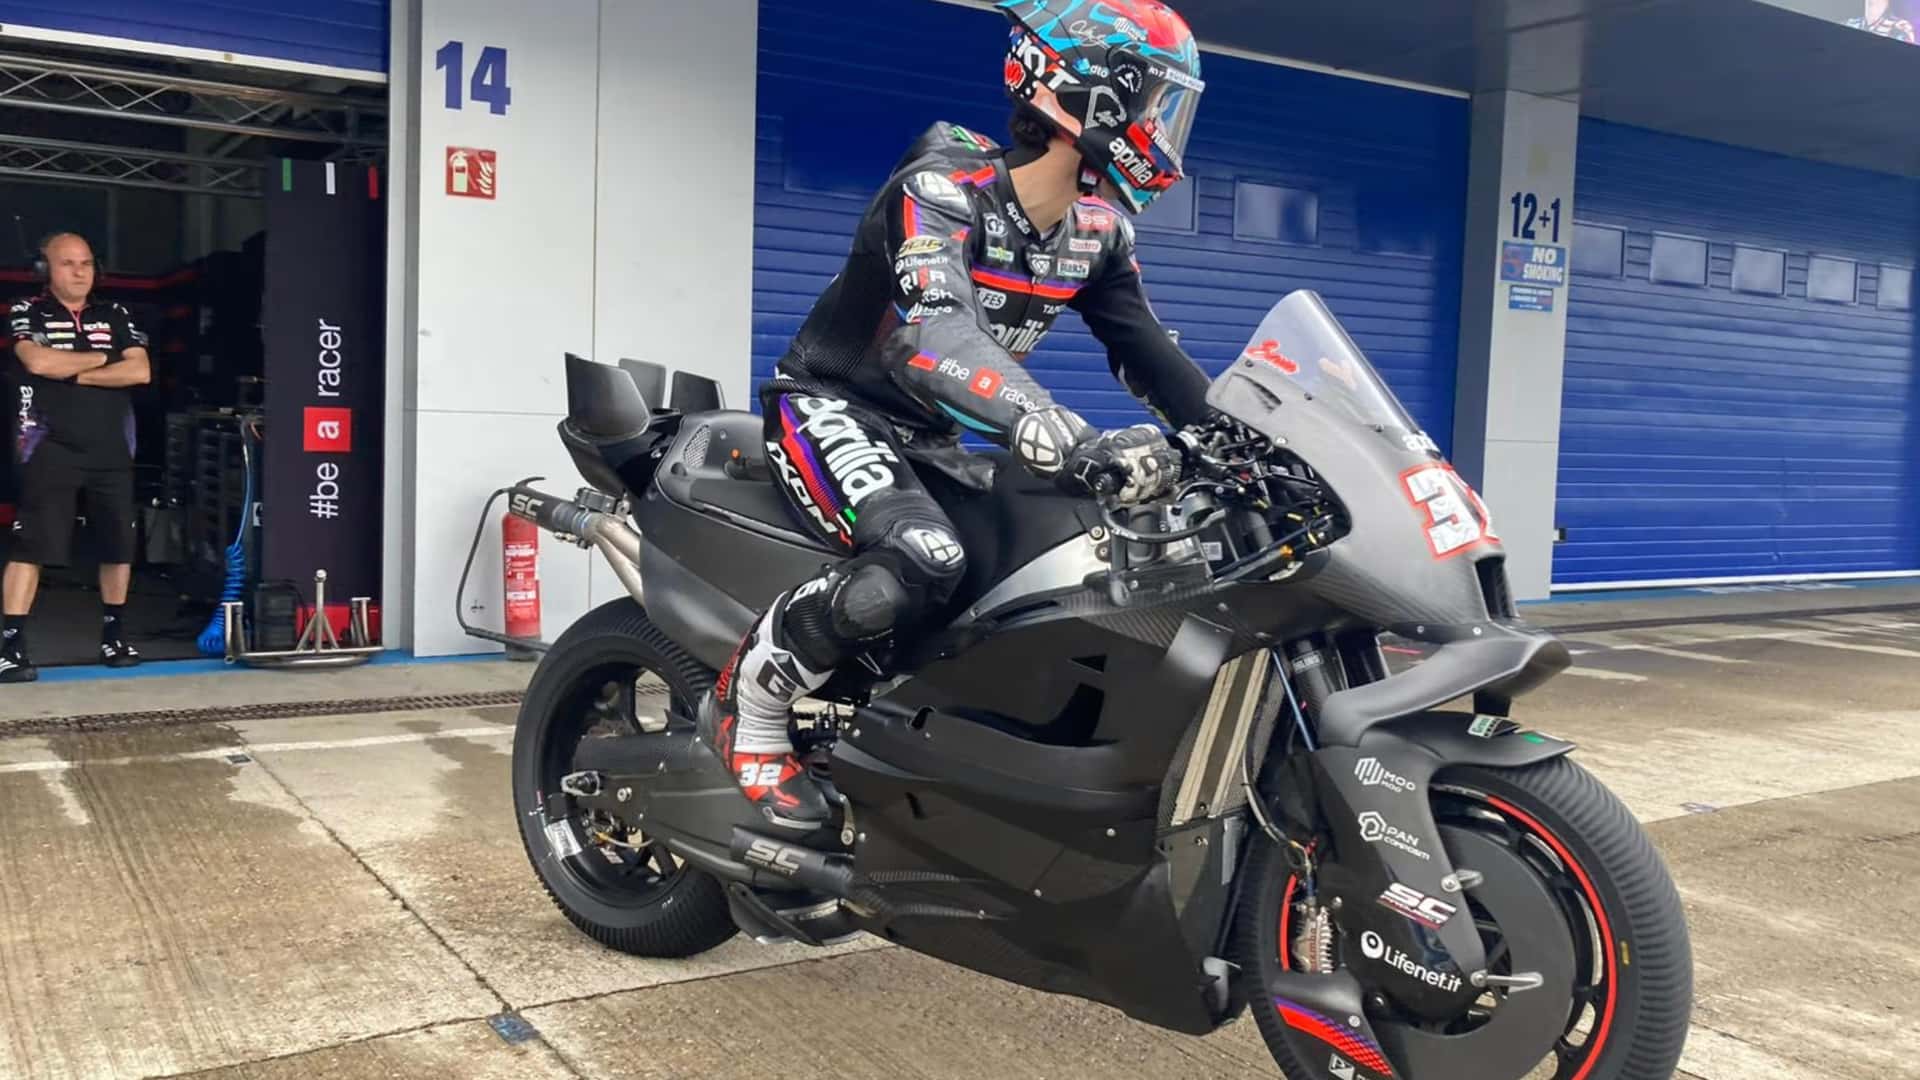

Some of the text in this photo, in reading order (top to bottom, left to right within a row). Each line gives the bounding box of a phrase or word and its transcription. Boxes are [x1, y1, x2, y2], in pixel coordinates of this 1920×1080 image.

[435, 40, 512, 116] 14
[1108, 136, 1153, 185] aprilia
[1511, 191, 1561, 244] 12+1
[1522, 262, 1563, 283] SMOKING
[1531, 246, 1557, 265] NO
[937, 357, 970, 381] #be
[977, 376, 993, 389] a
[309, 318, 342, 519] #be a racer
[796, 397, 900, 506] aprilia
[511, 494, 544, 517] SC
[739, 762, 783, 787] 32
[1386, 826, 1420, 846] PAN
[746, 839, 807, 870] SC
[1382, 882, 1457, 921] SC
[1384, 945, 1463, 993] Lifenet.it
